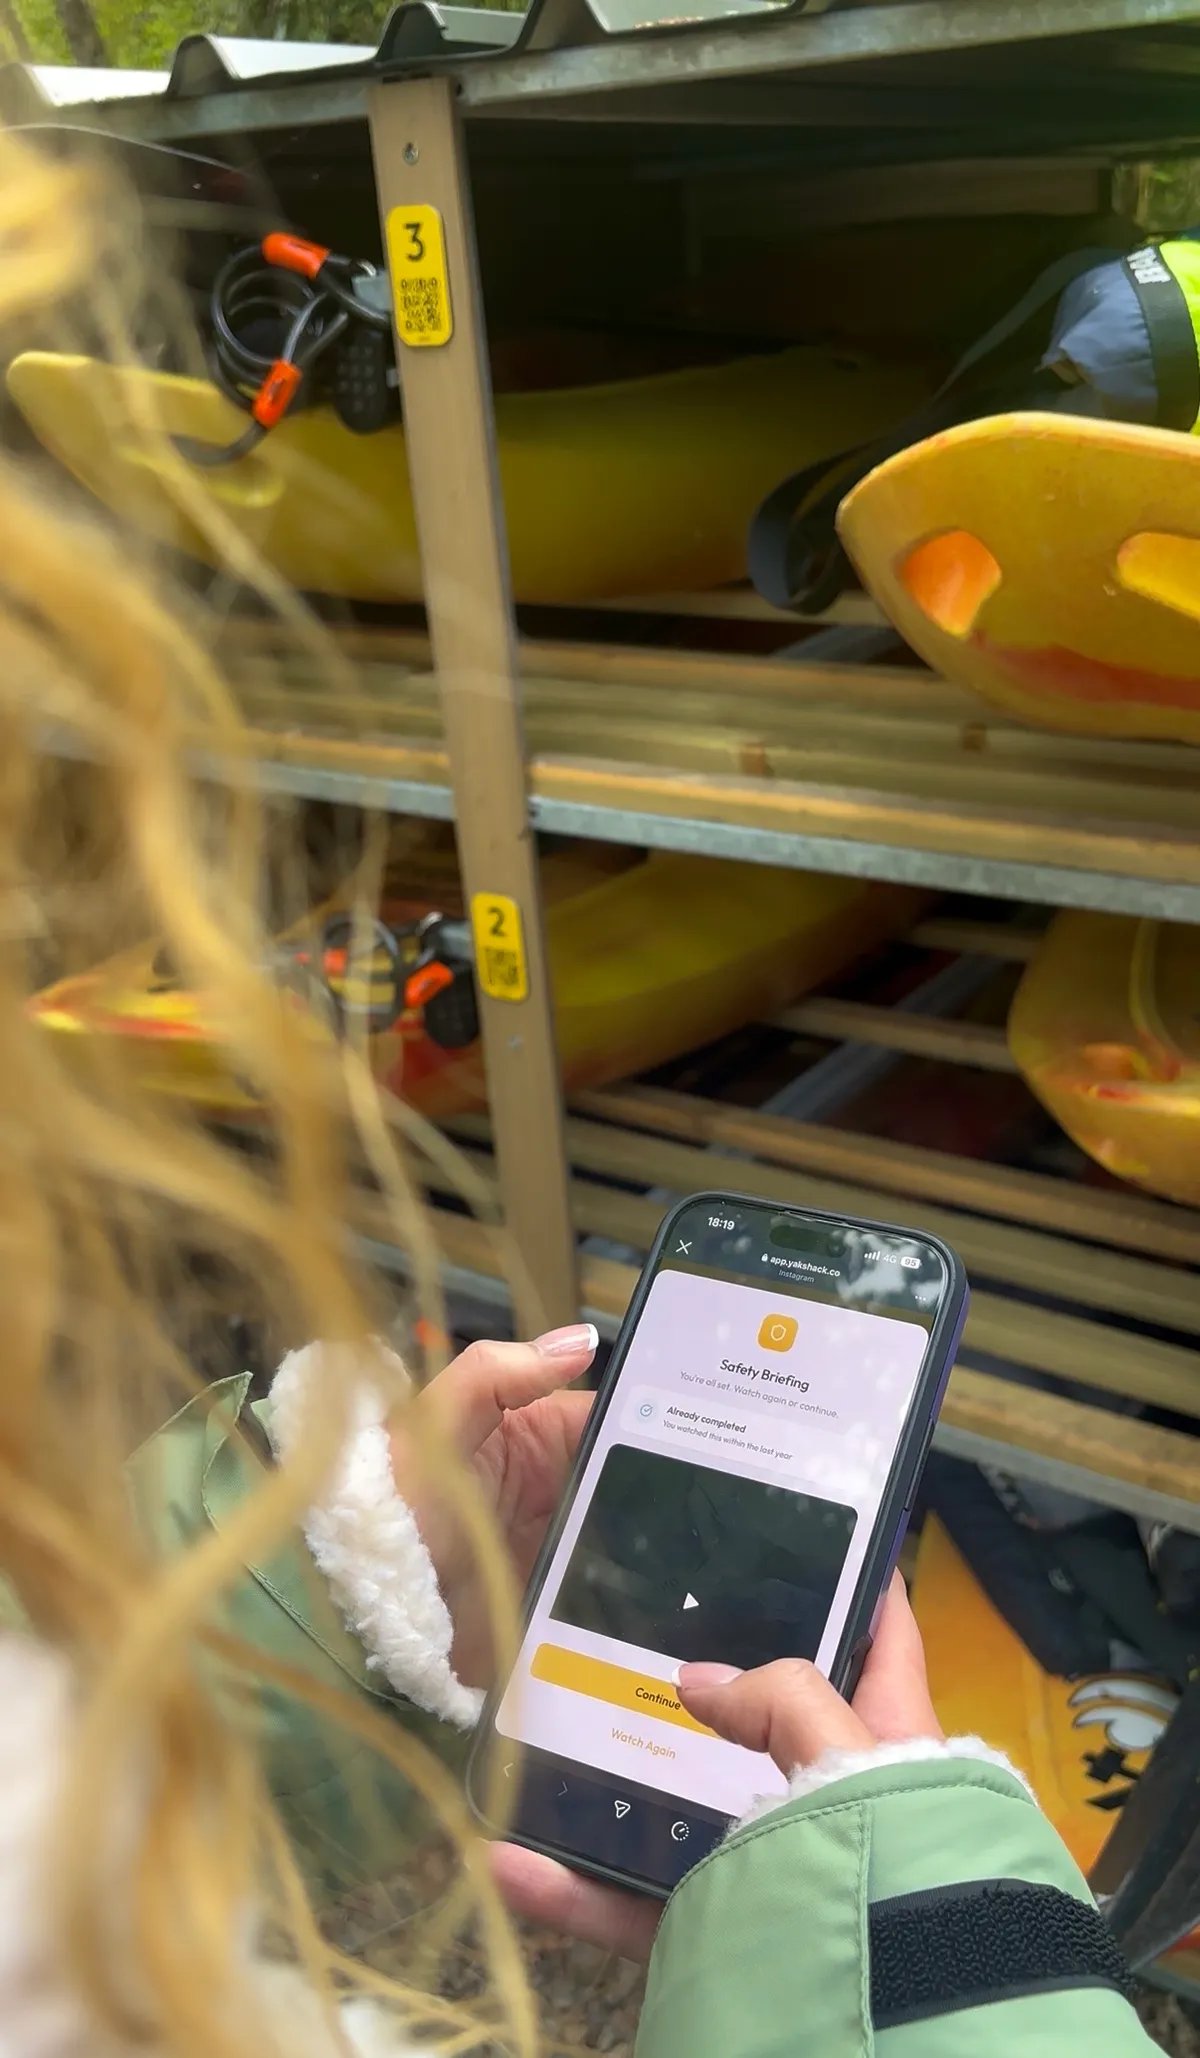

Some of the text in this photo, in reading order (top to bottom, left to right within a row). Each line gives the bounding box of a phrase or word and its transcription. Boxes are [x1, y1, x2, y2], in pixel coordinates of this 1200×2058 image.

[404, 222, 425, 262] 3
[487, 907, 507, 937] 2
[708, 1216, 735, 1230] 18:19
[770, 1254, 841, 1277] app.yakshack.co
[883, 1254, 917, 1267] 4G 95
[778, 1269, 815, 1283] Instagram
[720, 1359, 810, 1393] Safety Briefing
[680, 1371, 705, 1384] You're
[705, 1379, 717, 1388] all
[734, 1384, 761, 1399] Watch
[762, 1391, 787, 1404] again
[788, 1398, 799, 1408] or
[799, 1402, 839, 1419] continue.
[666, 1406, 747, 1434] Already completed
[663, 1419, 793, 1461] You watched this within the last year
[635, 1687, 681, 1710] Continue
[612, 1728, 676, 1759] Watch Again
